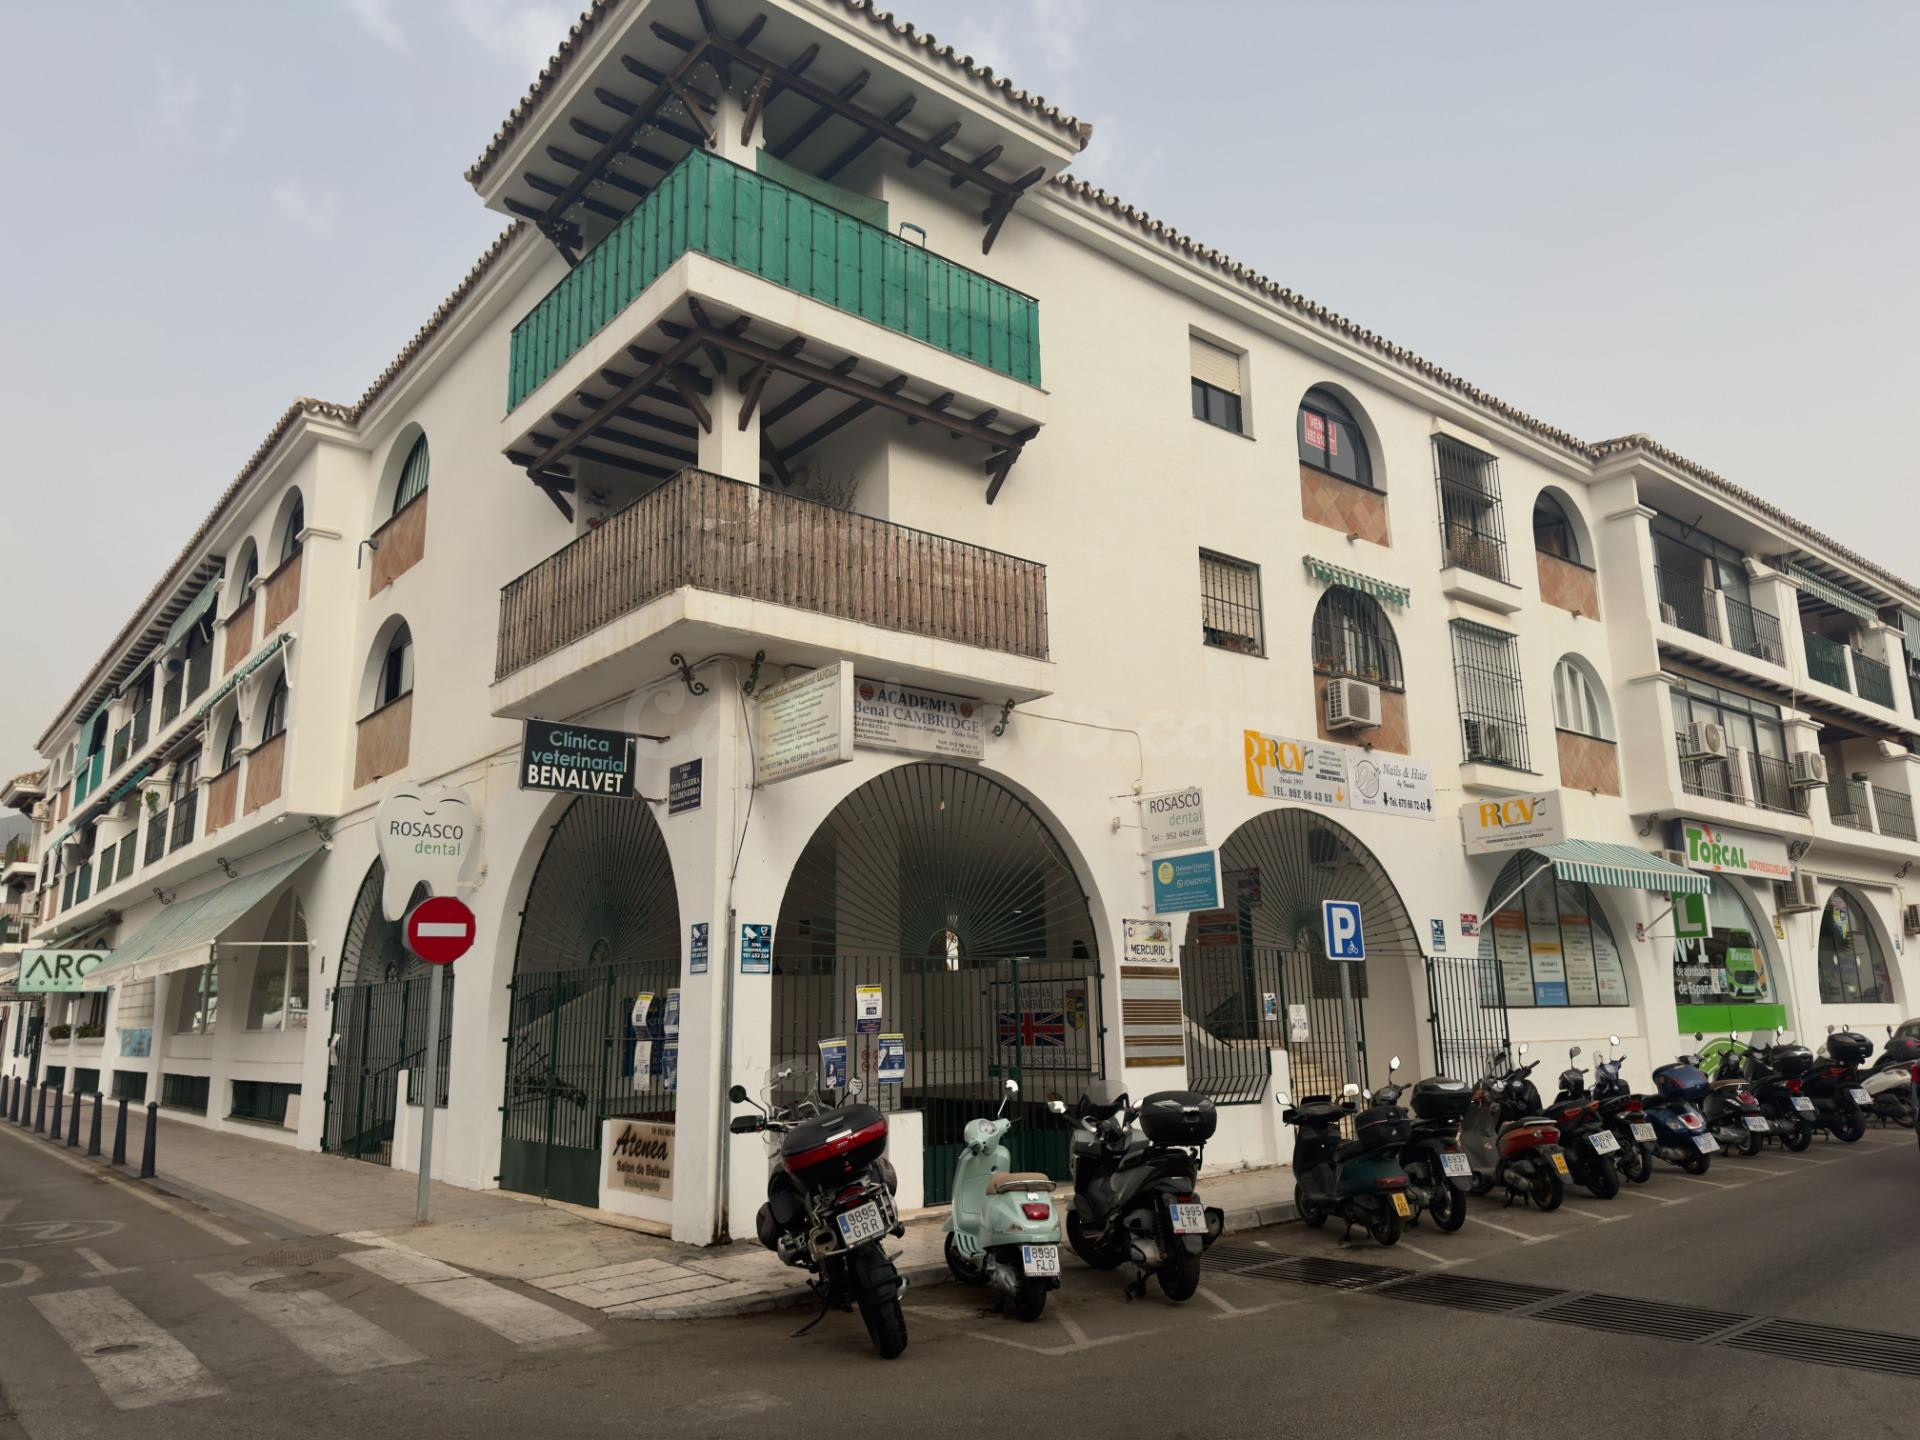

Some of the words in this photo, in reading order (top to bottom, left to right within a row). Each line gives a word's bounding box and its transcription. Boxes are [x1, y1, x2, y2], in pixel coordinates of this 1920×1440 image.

[878, 689, 958, 715] ACADEMIA
[854, 701, 889, 717] Benal
[893, 708, 981, 733] CAMBRIDGE
[549, 731, 610, 753] Clínica
[532, 749, 624, 773] veterinaria
[1262, 738, 1306, 775] RCV
[528, 764, 624, 793] BENALVET
[1383, 763, 1401, 777] Nails
[1403, 767, 1409, 777] &
[1411, 768, 1428, 781] Hair
[1150, 792, 1200, 814] ROSASCO
[1479, 797, 1535, 828] RCV
[390, 820, 463, 840] ROSASCO
[1169, 811, 1202, 827] dental
[415, 841, 460, 856] dental
[1749, 859, 1788, 876] AUTOESCUELAS
[1676, 897, 1703, 931] L
[1331, 907, 1356, 953] P
[1130, 944, 1166, 956] MERCURIO
[613, 1124, 669, 1162] Atenea
[636, 1163, 644, 1175] de
[646, 1164, 671, 1179] Belleza
[848, 1204, 877, 1226] 9895
[1179, 1205, 1202, 1217] 4995
[1182, 1216, 1198, 1227] LTK
[853, 1218, 879, 1238] GRR
